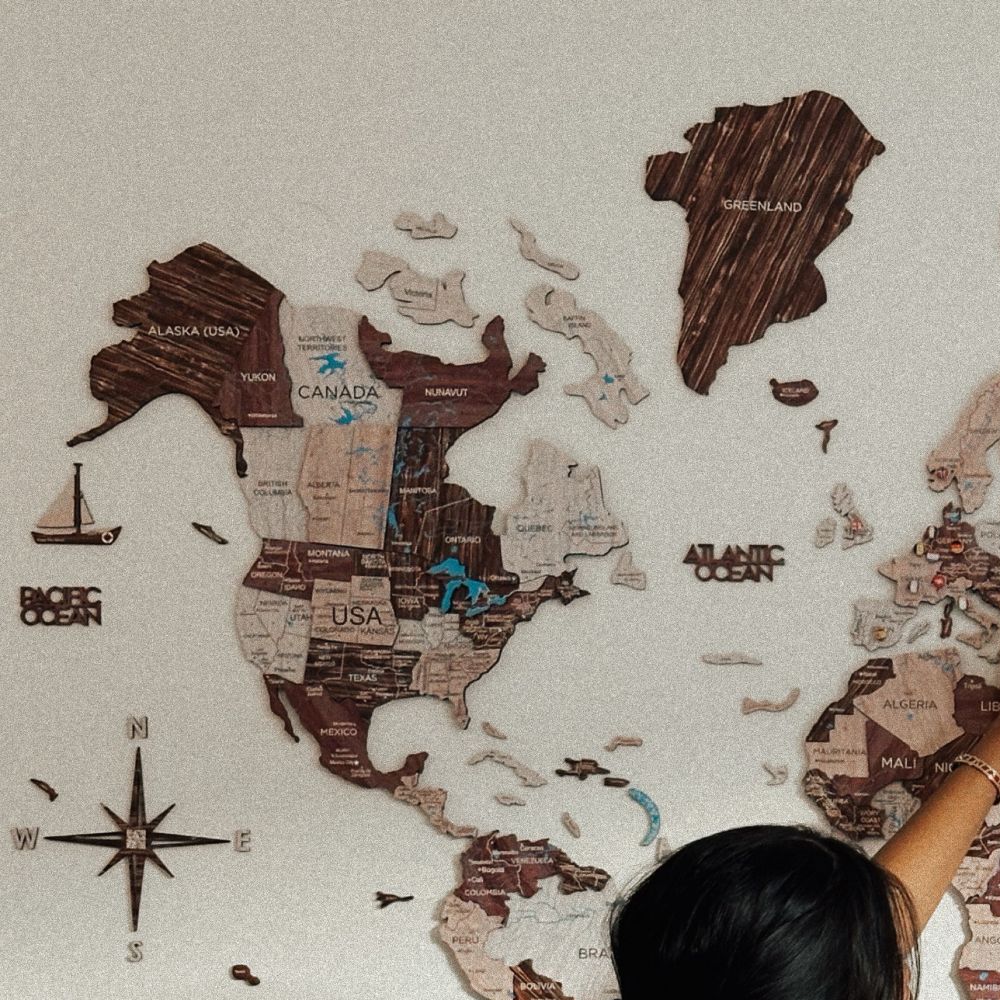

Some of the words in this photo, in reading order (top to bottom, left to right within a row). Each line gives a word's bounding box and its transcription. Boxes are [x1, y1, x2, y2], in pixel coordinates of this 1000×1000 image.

[723, 199, 802, 212] GREENLAND
[148, 326, 200, 337] ALASKA
[203, 325, 240, 338] (USA)
[240, 373, 276, 382] YUKON
[298, 384, 378, 400] CANADA
[425, 388, 468, 397] NUNAVUT
[682, 544, 785, 566] ATLANTIC
[694, 564, 774, 582] OCEAN
[20, 586, 102, 607] PACIFIC
[20, 606, 102, 626] OCEAN
[332, 606, 382, 625] USA
[349, 674, 377, 682] TEXAS
[883, 699, 937, 709] ALGERIA
[980, 702, 1000, 712] LIB
[127, 715, 149, 739] N
[320, 728, 358, 737] MEXICO
[881, 757, 917, 769] MALI
[10, 827, 39, 850] W
[234, 830, 251, 852] E
[127, 941, 143, 962] S
[578, 948, 609, 959] BRA
